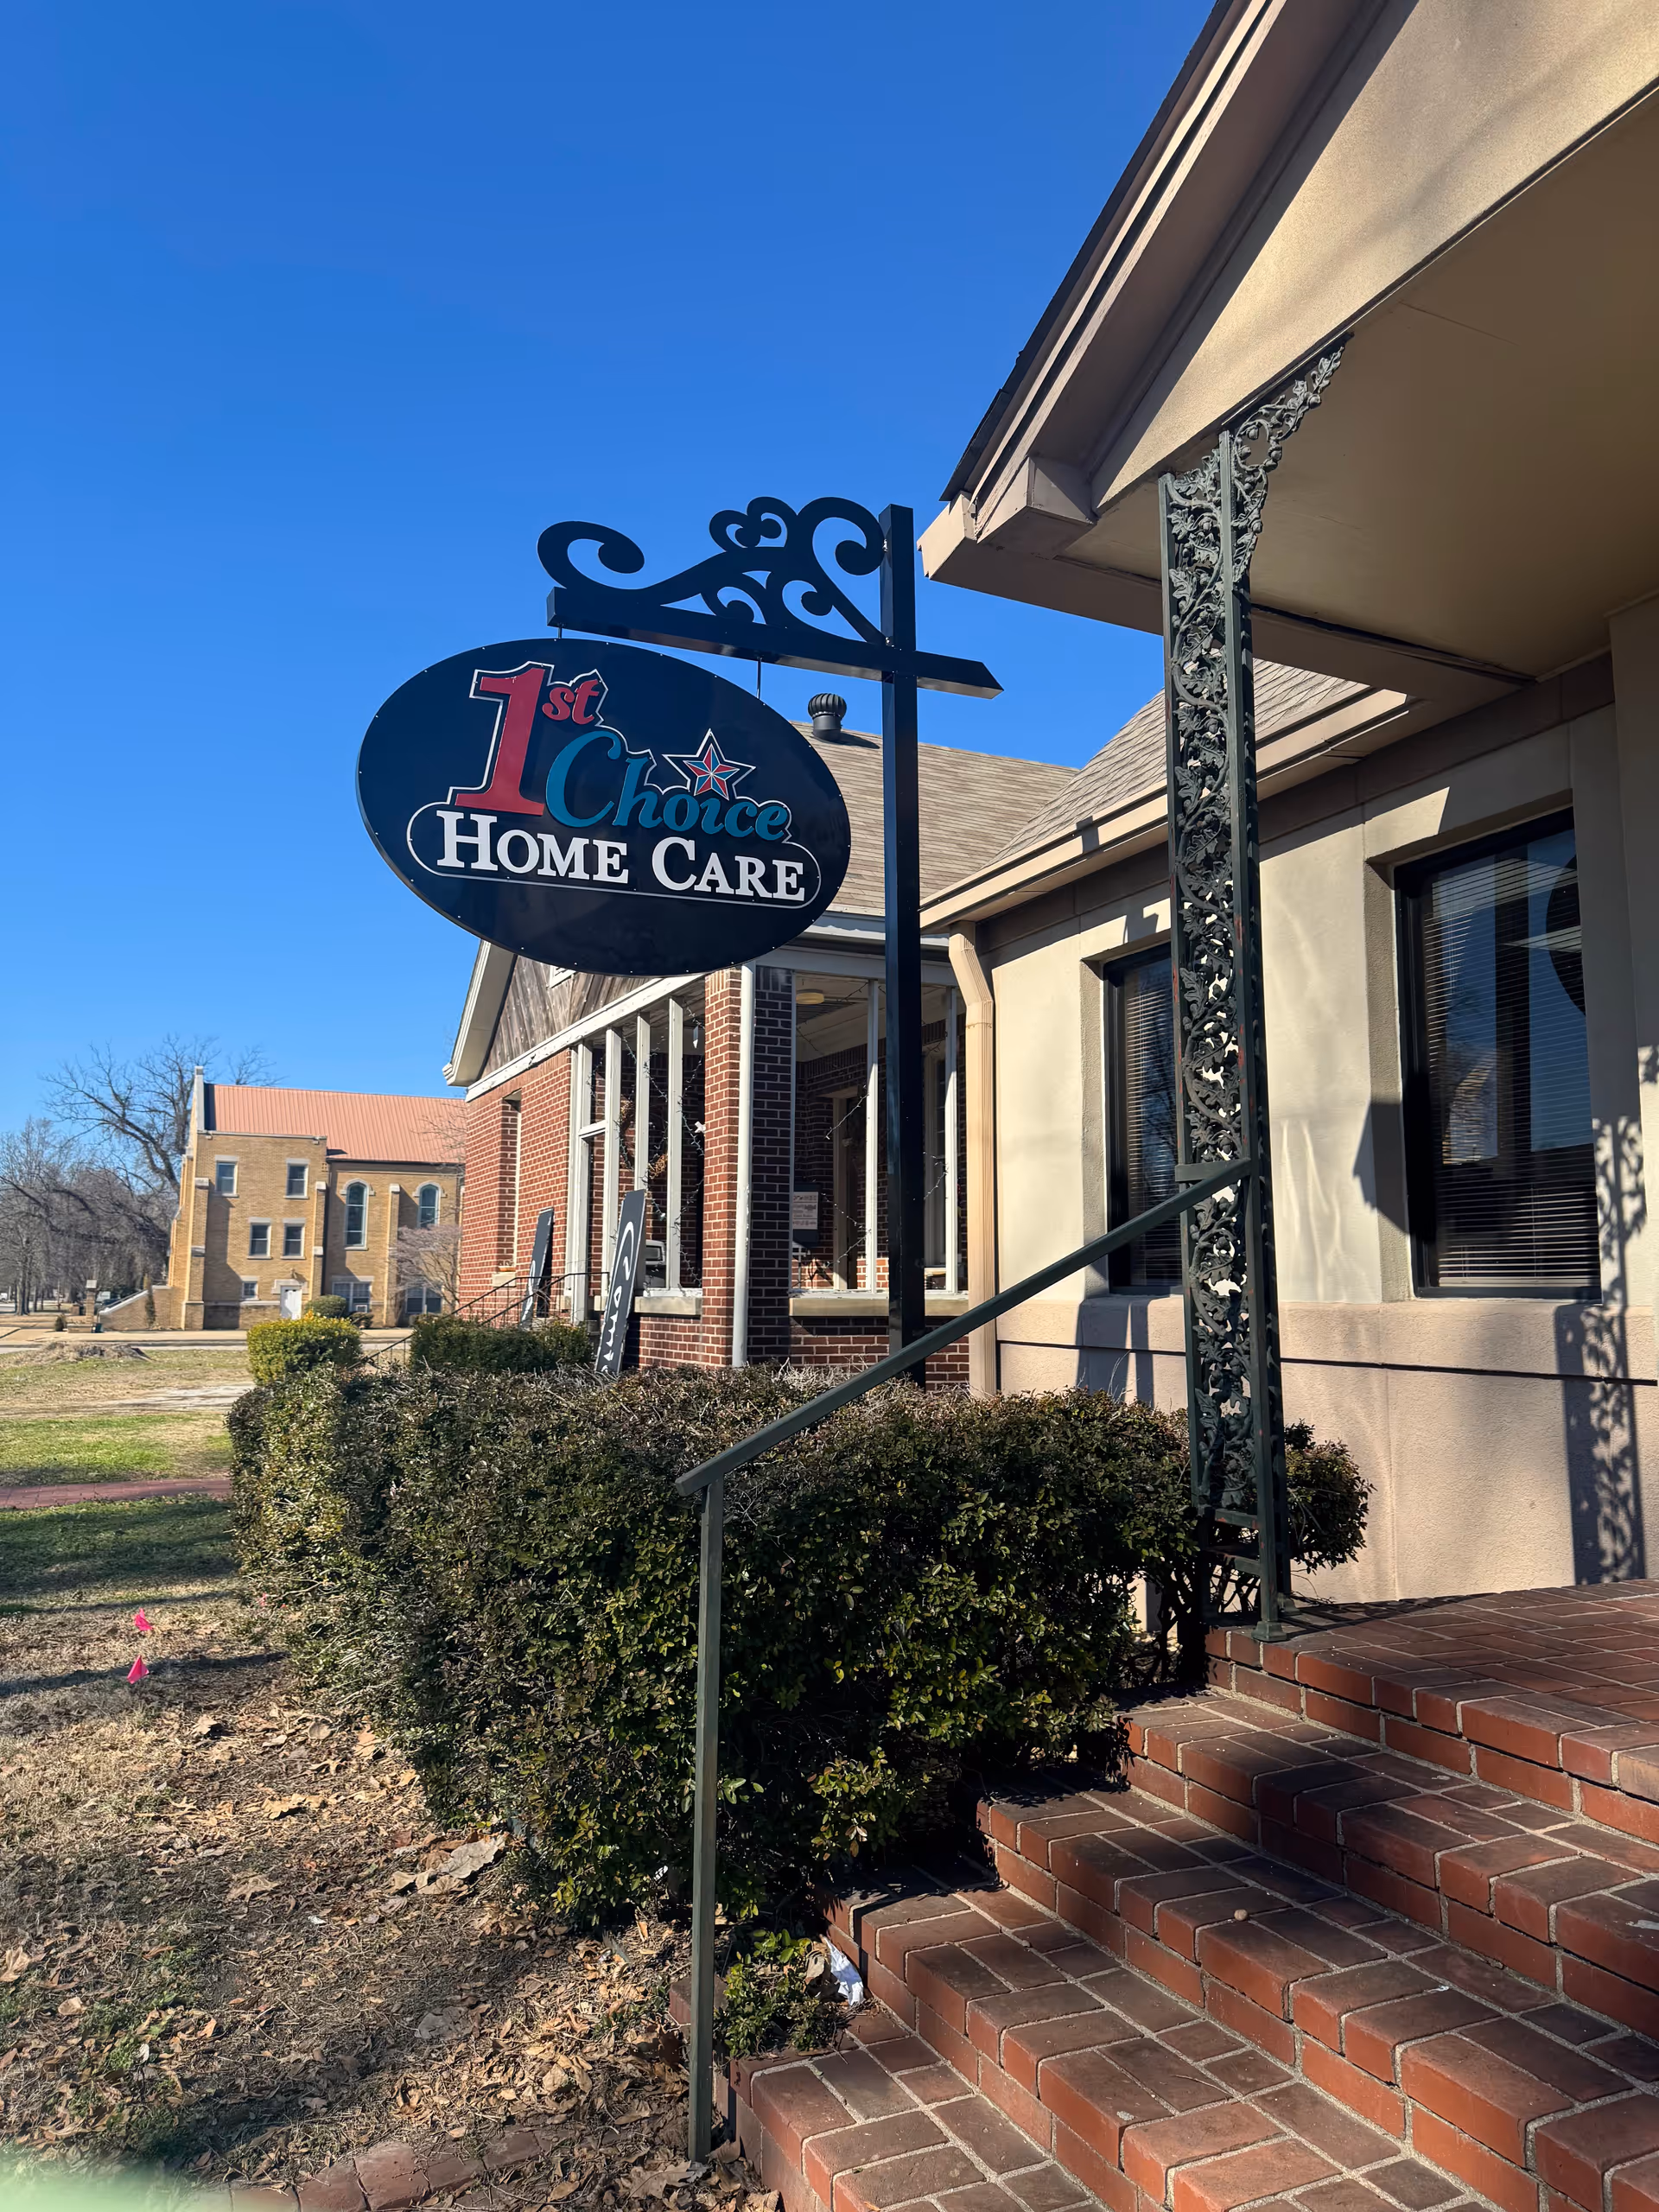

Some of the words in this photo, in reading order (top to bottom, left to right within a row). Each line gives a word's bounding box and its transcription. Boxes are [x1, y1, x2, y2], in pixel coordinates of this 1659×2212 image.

[454, 667, 600, 816] 1st
[545, 730, 789, 841] Choice
[436, 810, 629, 883] HOME
[652, 836, 806, 902] CARE
